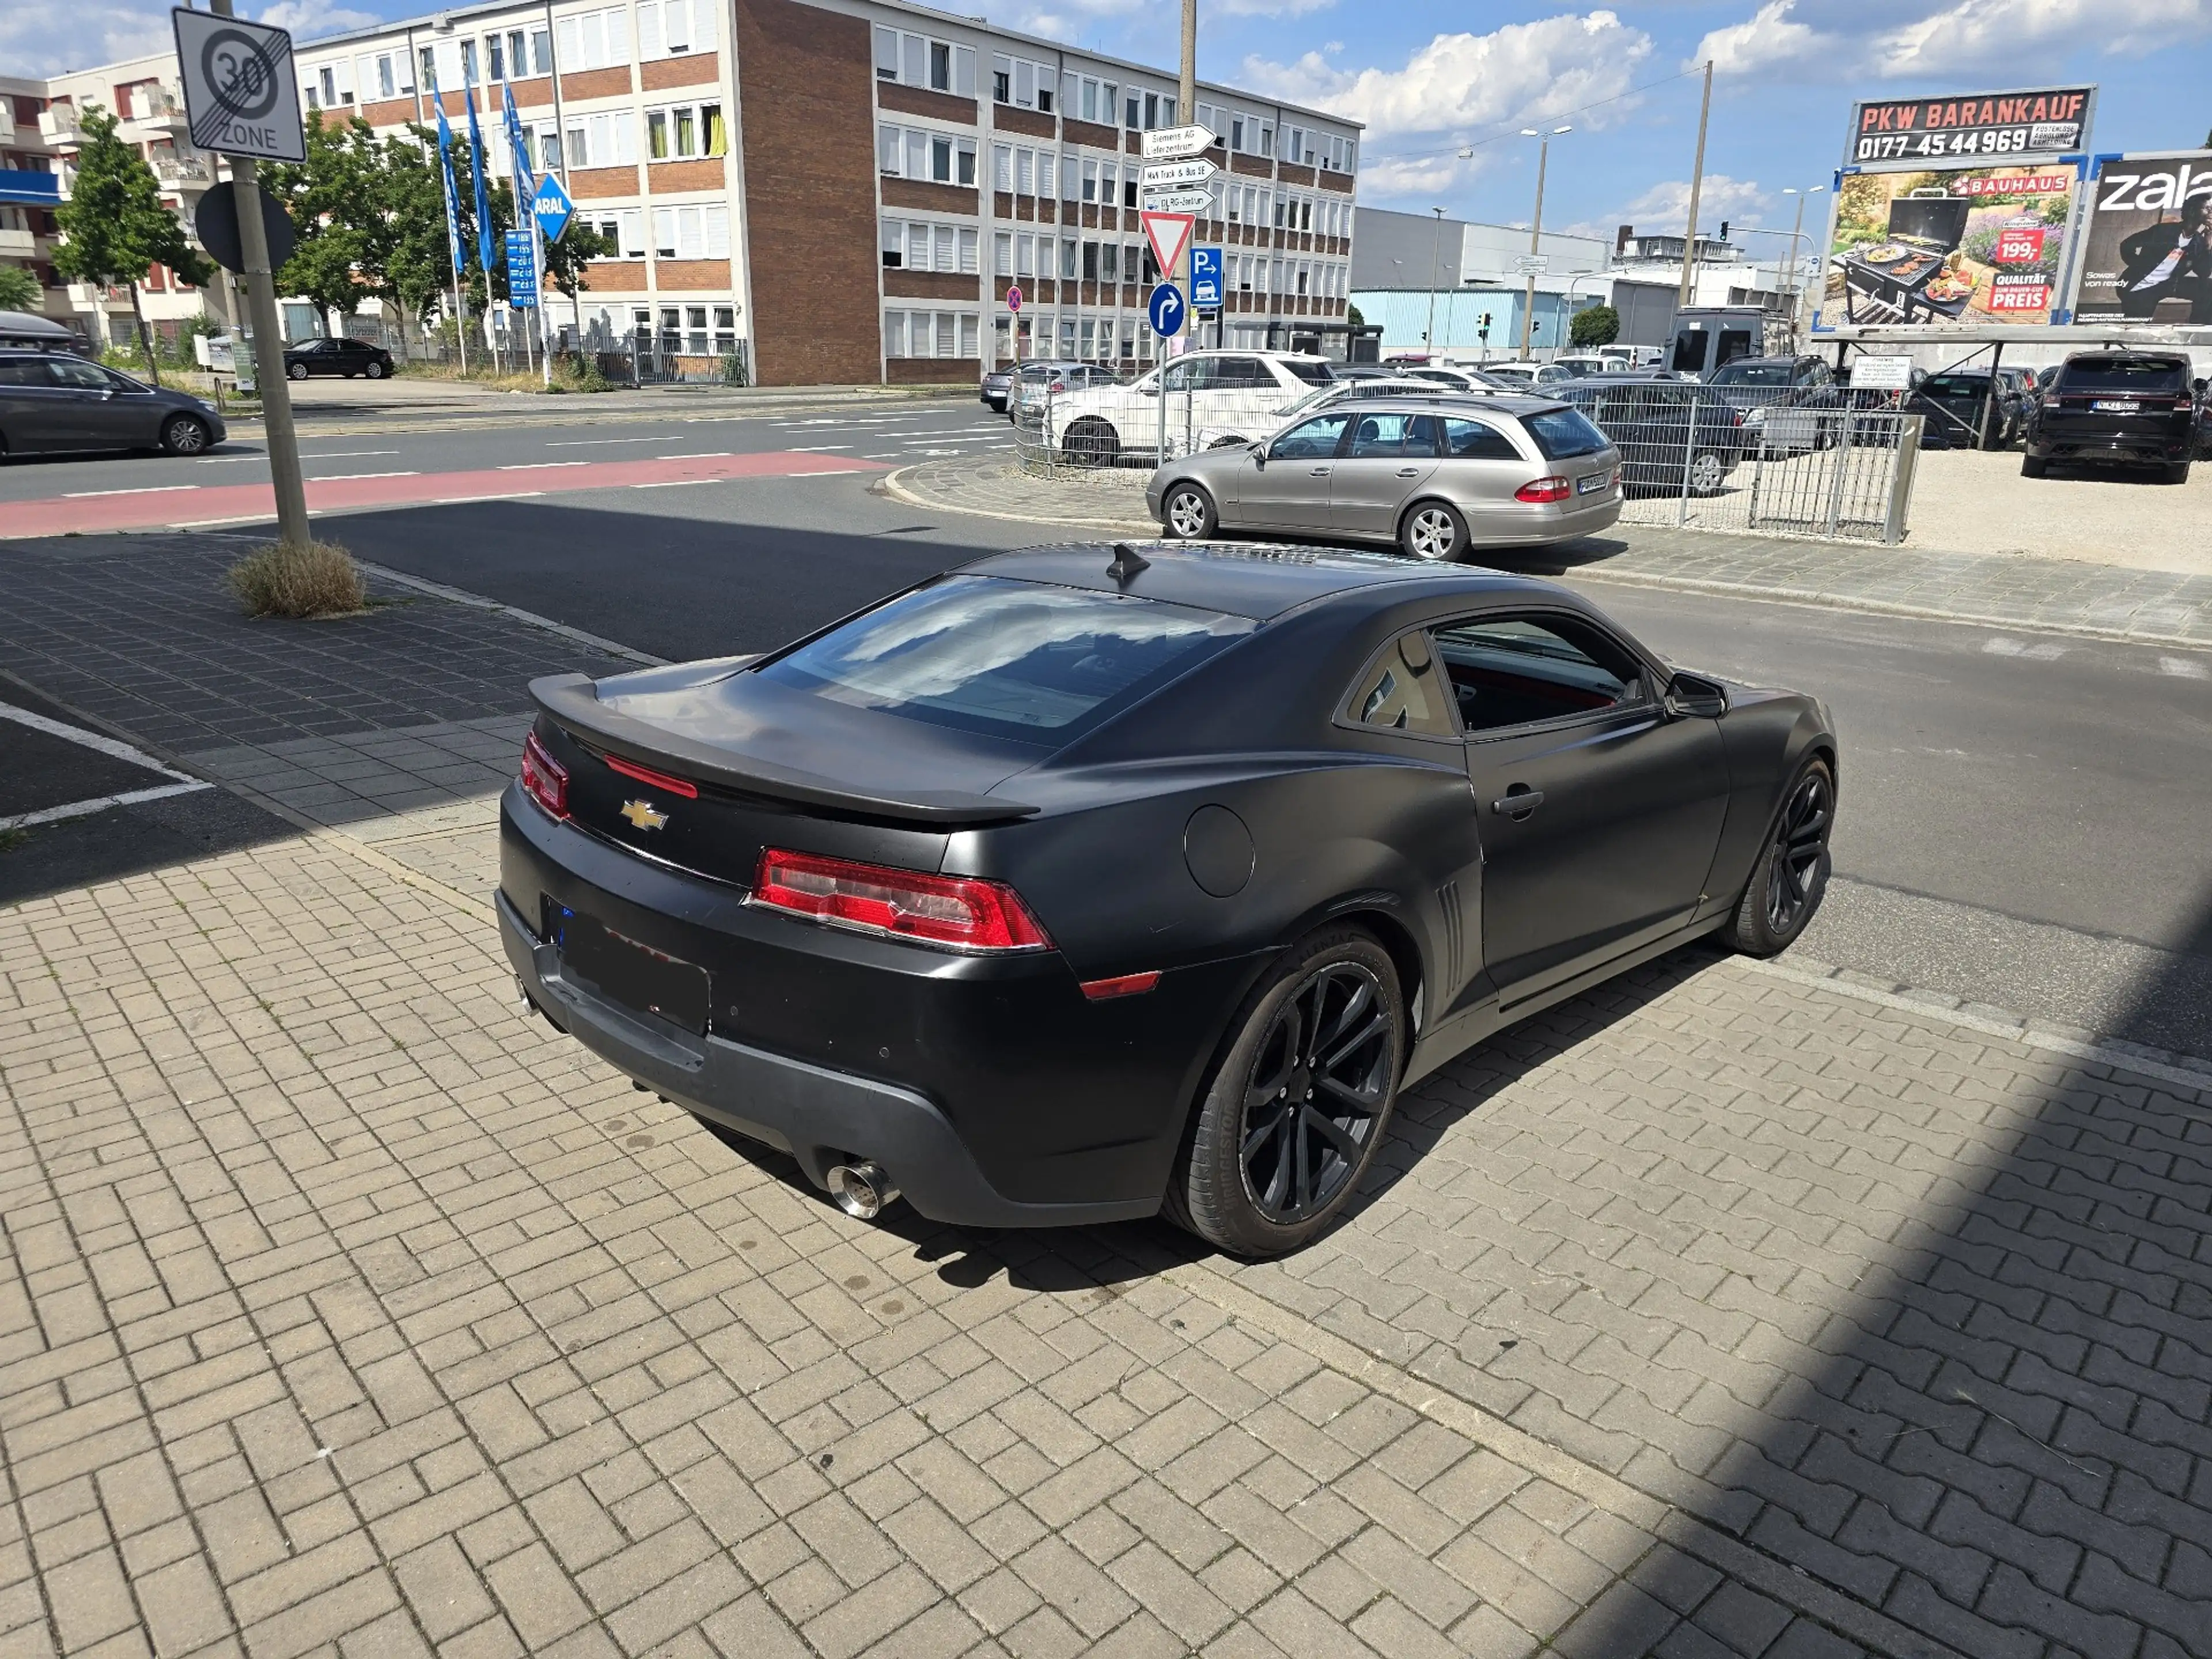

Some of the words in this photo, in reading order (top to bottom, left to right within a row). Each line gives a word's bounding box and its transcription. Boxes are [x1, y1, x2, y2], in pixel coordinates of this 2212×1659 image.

[217, 52, 264, 97] 30
[1861, 105, 1919, 132] PKW
[1926, 94, 2084, 129] BARANKAUF
[221, 121, 278, 150] ZONE
[1152, 133, 1181, 143] Siemens
[1184, 130, 1195, 139] AG
[1146, 143, 1195, 156] Lieferzentrum
[1858, 136, 1909, 160] 0177
[1916, 134, 1946, 156] 45
[1949, 132, 1978, 154] 44
[1981, 129, 2027, 153] 969
[1147, 171, 1159, 180] MAN
[1161, 169, 1175, 179] Truck
[1179, 169, 1183, 177] &
[1185, 166, 1195, 176] Bus
[1198, 165, 1205, 175] SE
[1971, 176, 2067, 192] BAUHAUS
[535, 196, 567, 215] ARAL
[1161, 196, 1204, 208] DLRG-Zentrum
[2001, 241, 2038, 260] 199,-
[1194, 251, 1210, 274] P
[1997, 273, 2047, 286] QUALITÄT
[2103, 279, 2129, 288] ready
[1992, 292, 2043, 308] PREIS
